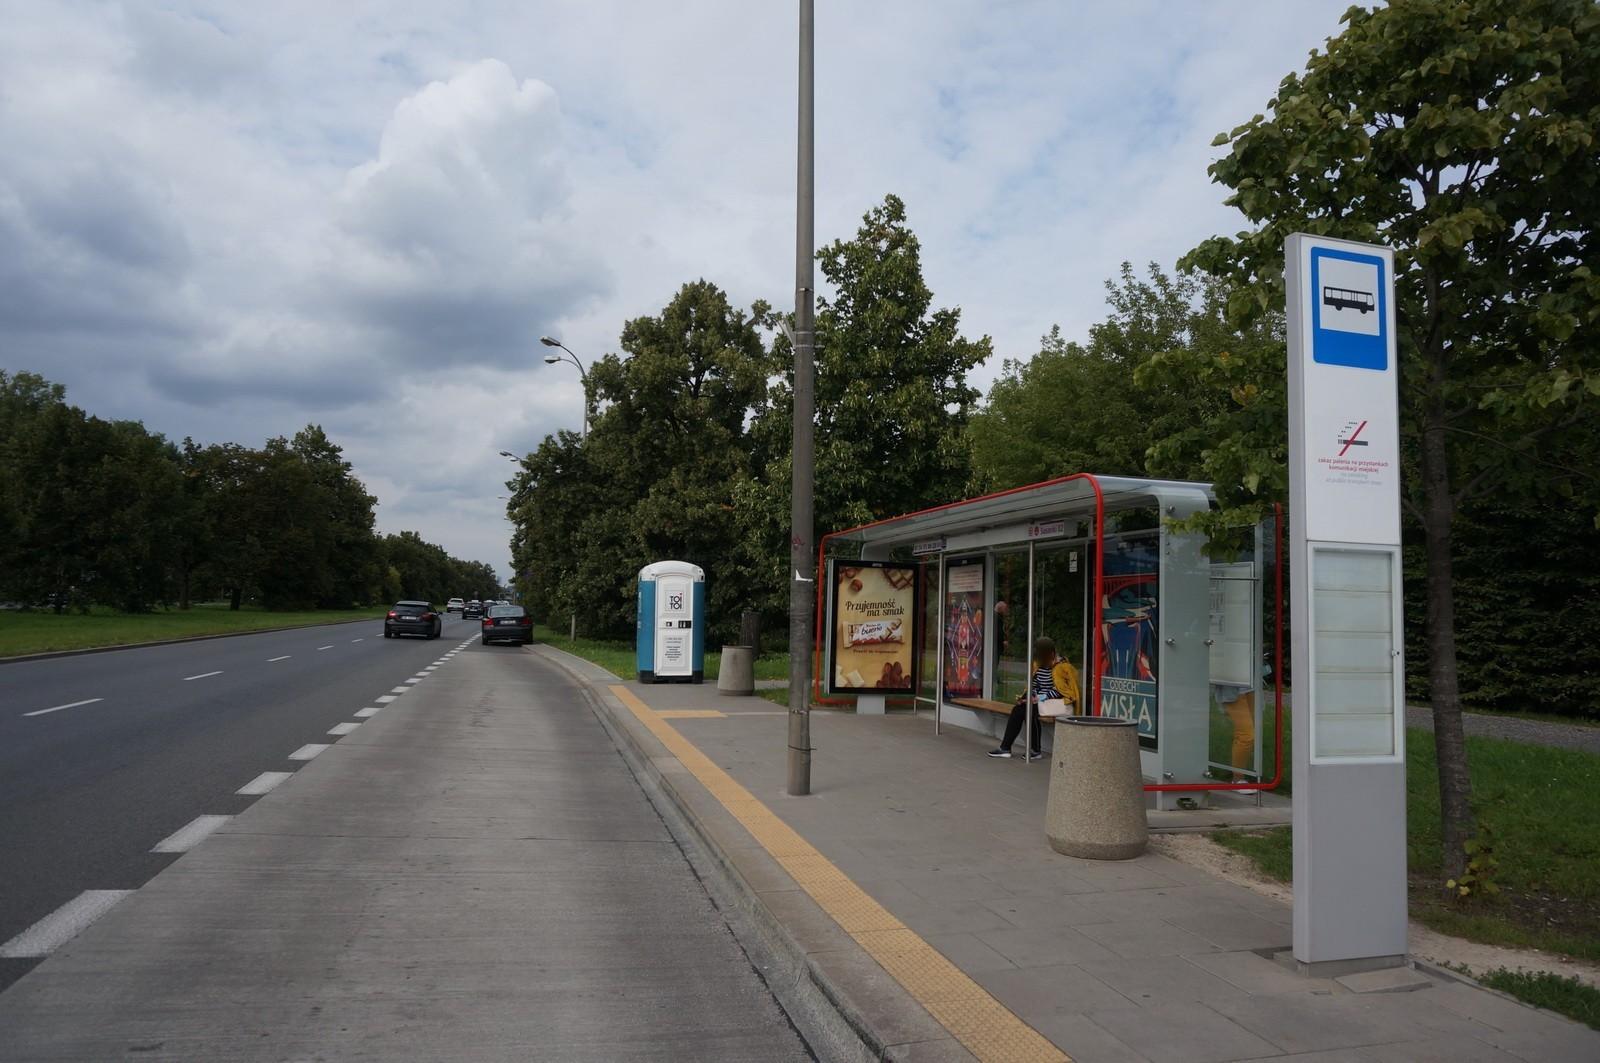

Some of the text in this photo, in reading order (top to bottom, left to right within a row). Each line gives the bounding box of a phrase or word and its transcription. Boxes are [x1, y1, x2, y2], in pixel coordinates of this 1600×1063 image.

[669, 602, 682, 610] TOI
[846, 598, 896, 613] Przyjemność
[866, 605, 905, 617] ma smak
[861, 625, 882, 636] bueno
